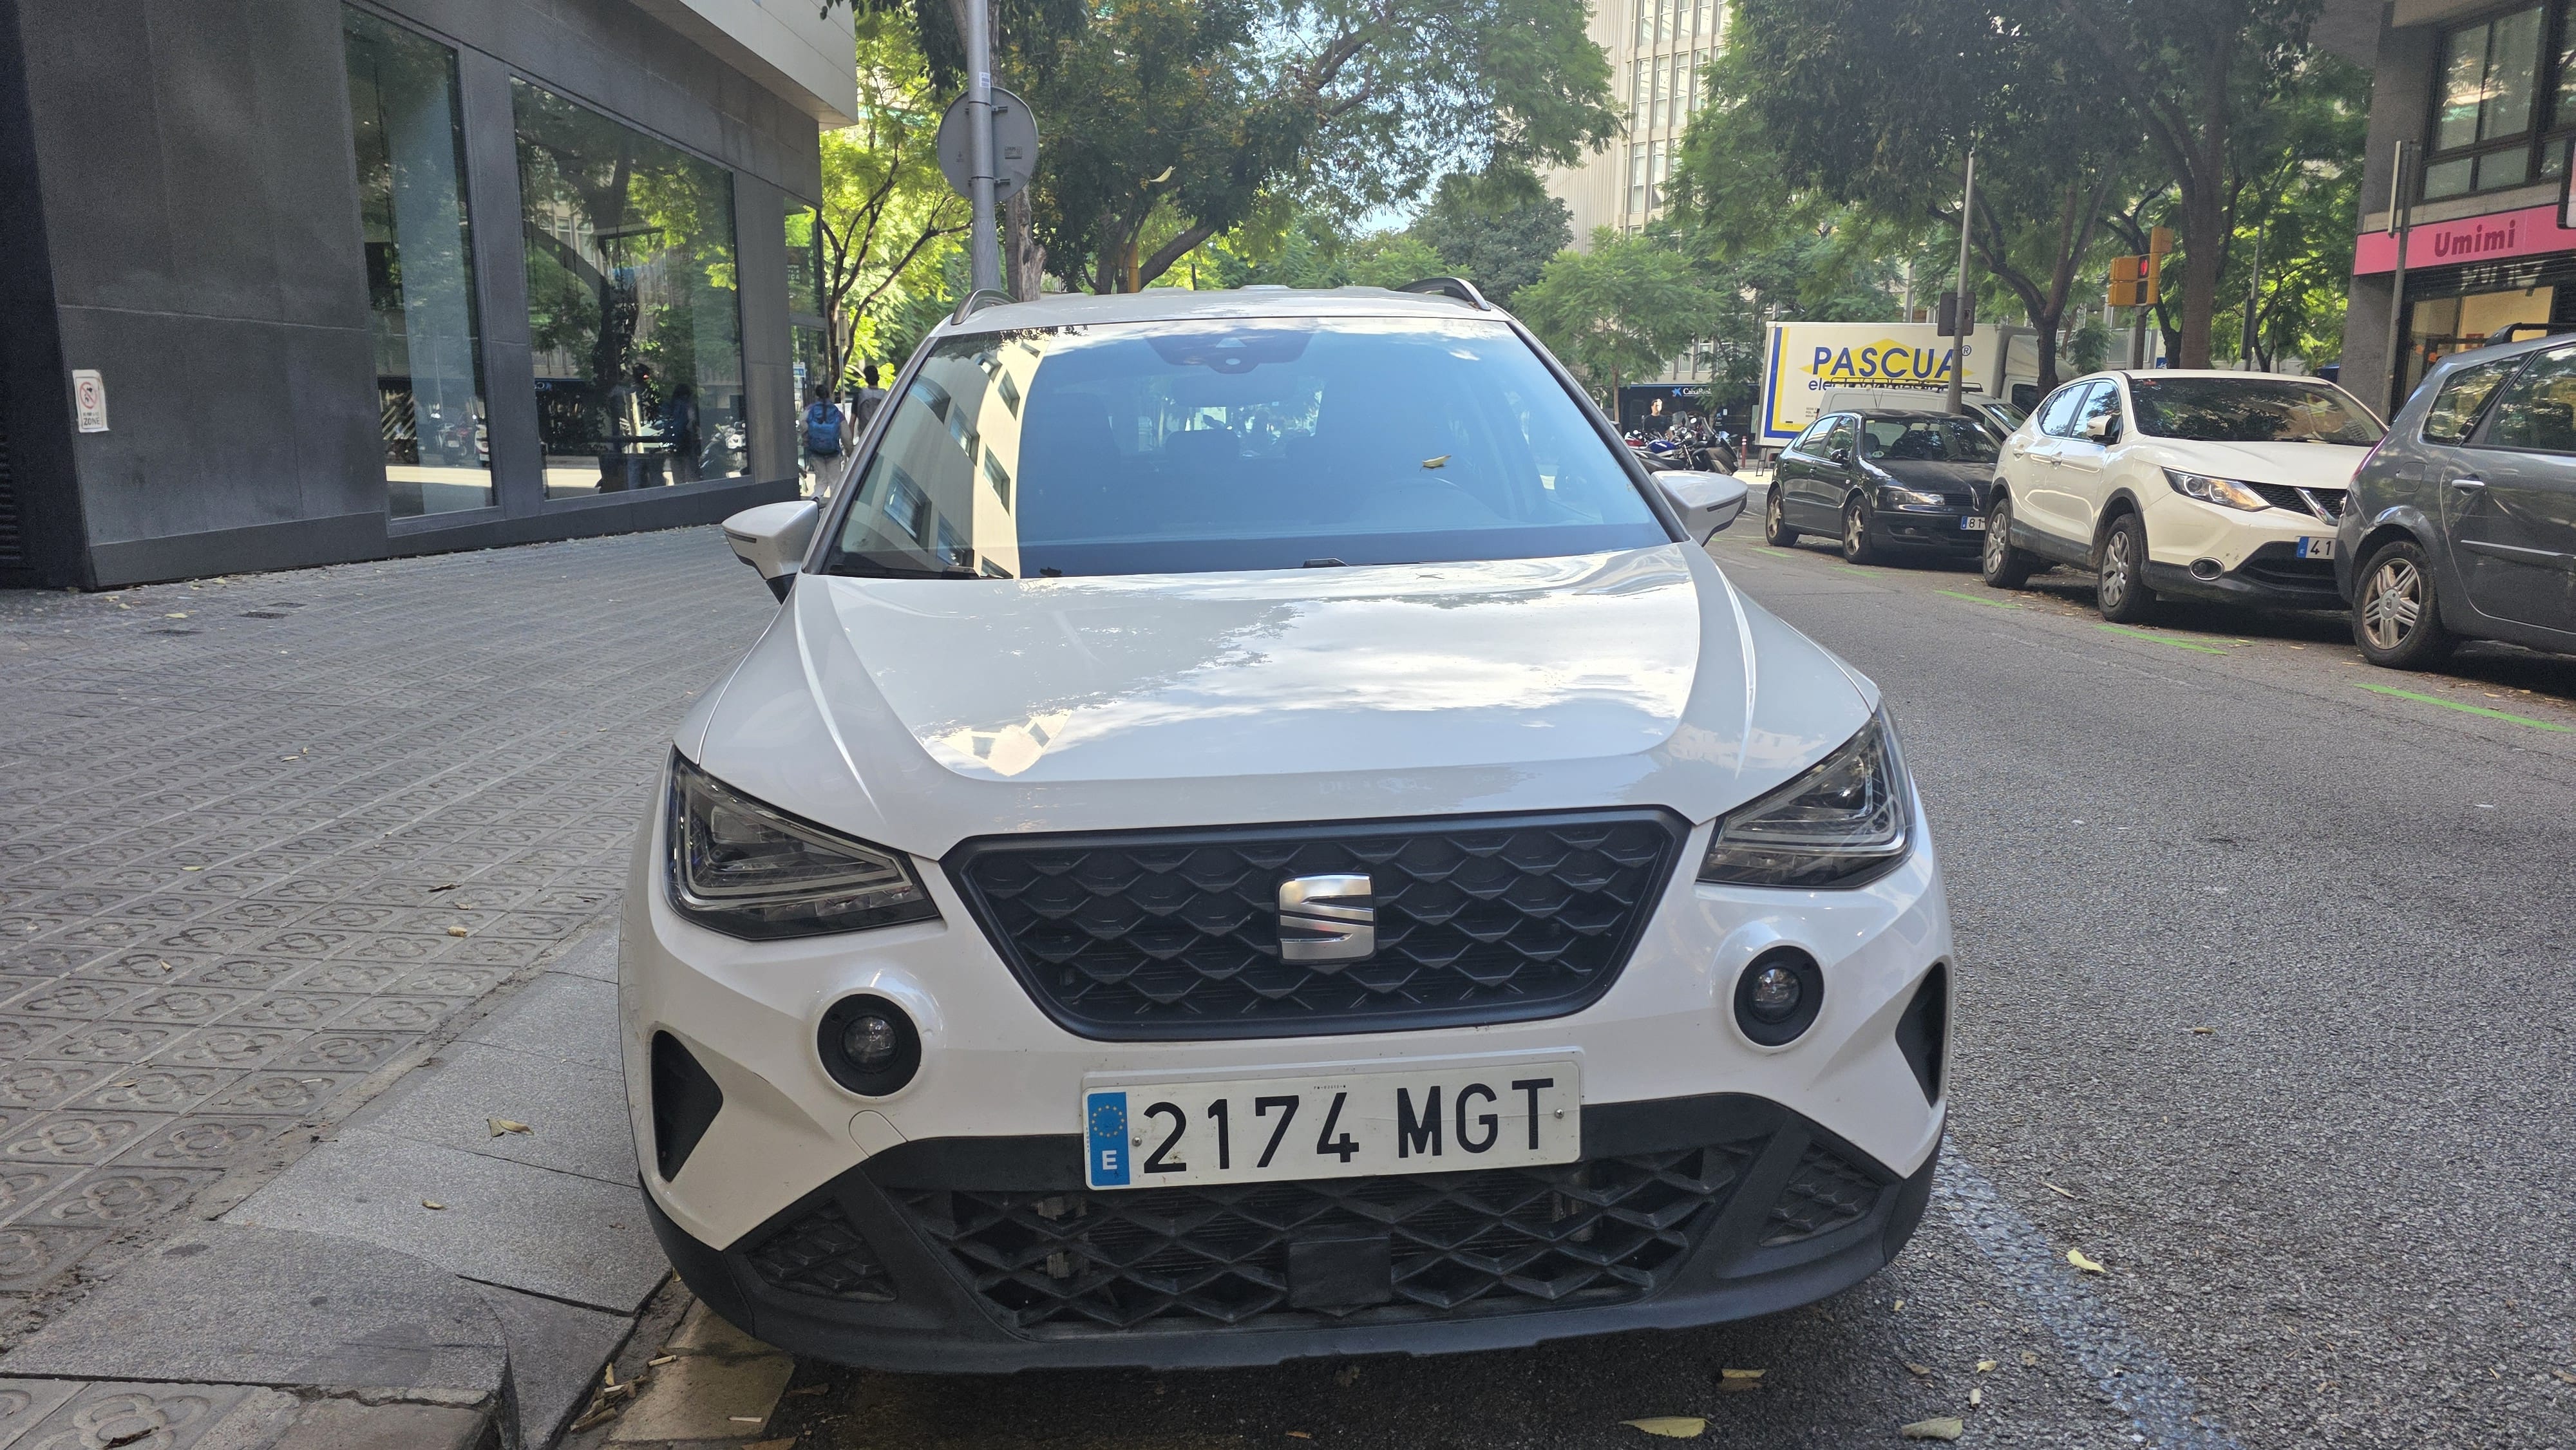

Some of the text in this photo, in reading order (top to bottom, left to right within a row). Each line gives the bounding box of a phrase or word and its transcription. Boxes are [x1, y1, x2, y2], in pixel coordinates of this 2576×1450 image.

[2434, 219, 2516, 258] Umimi
[1812, 346, 1955, 379] PASCUA
[83, 417, 100, 426] ZONE
[2309, 540, 2331, 556] 41
[1102, 1078, 1554, 1174] E 2174 MGT
